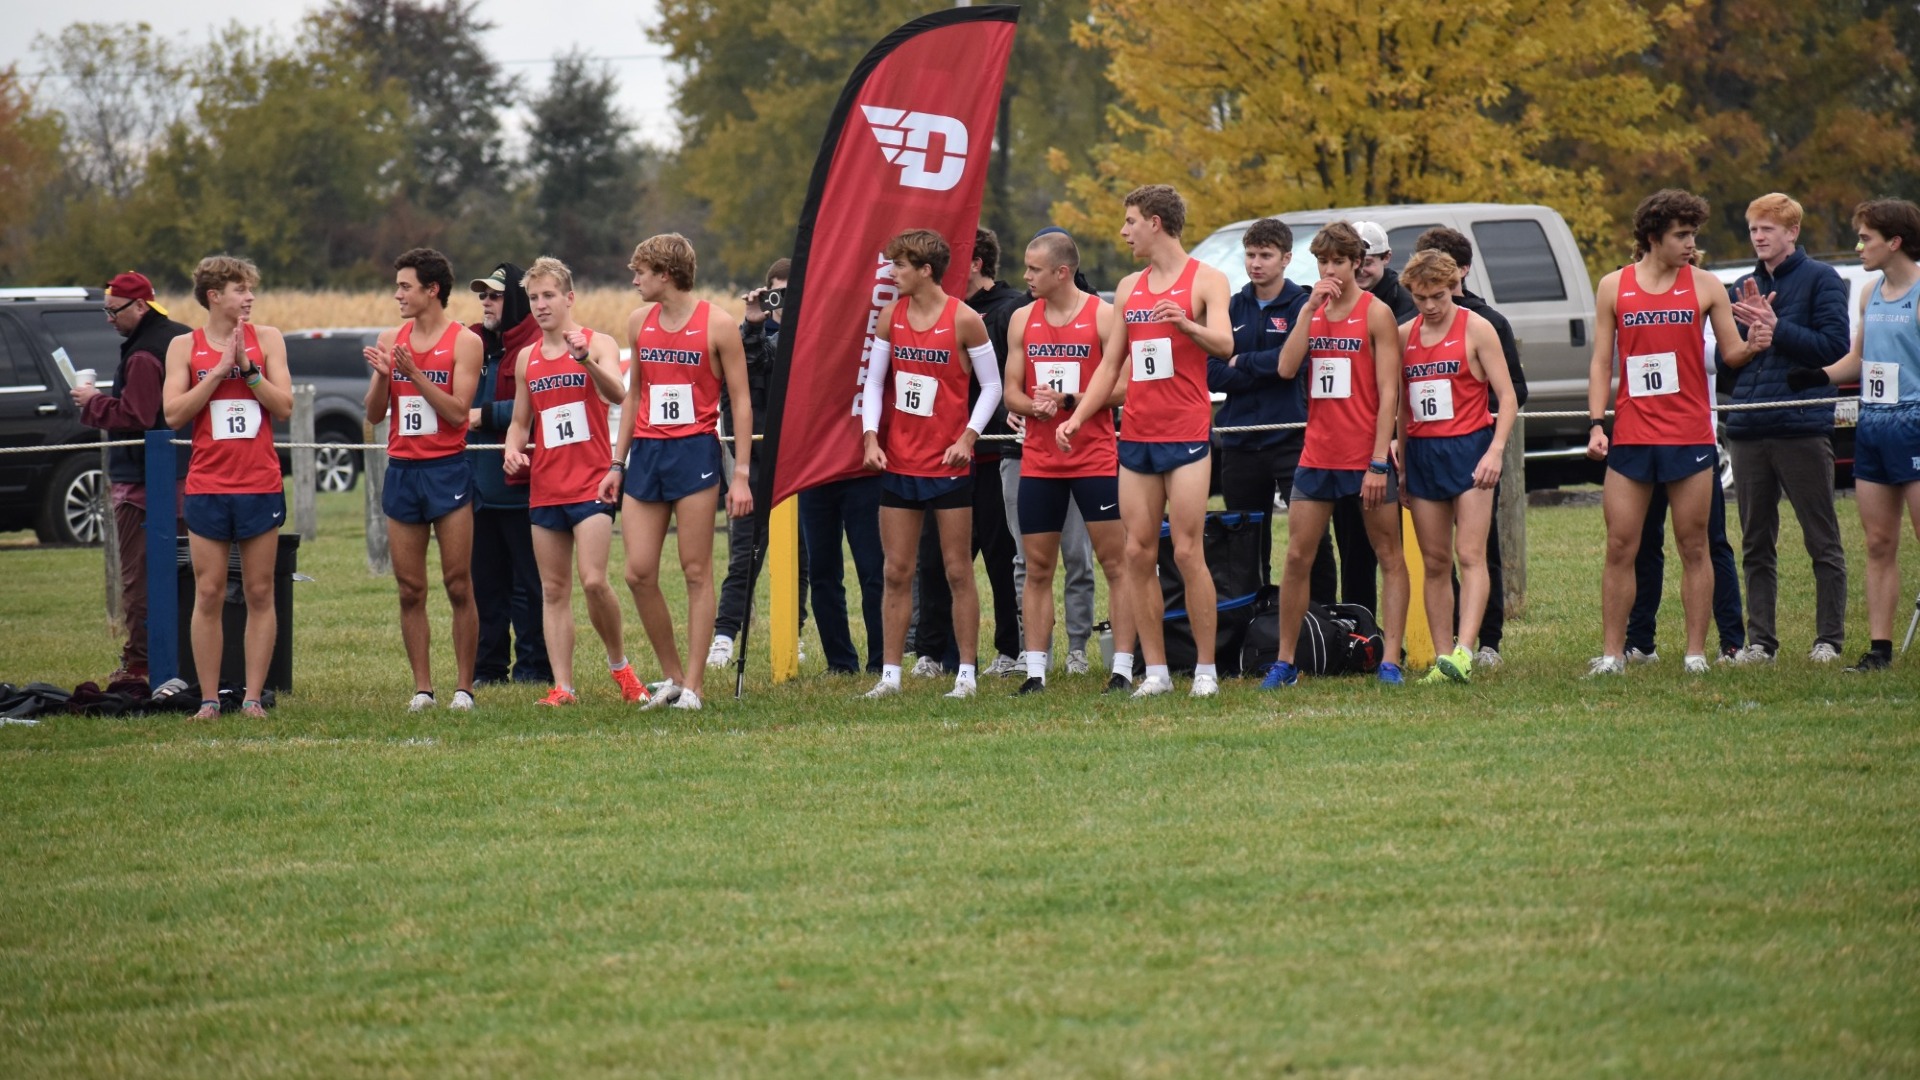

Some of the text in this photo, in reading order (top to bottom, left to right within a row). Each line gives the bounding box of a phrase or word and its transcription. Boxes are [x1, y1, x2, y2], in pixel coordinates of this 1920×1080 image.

[1623, 310, 1694, 327] DAYTON
[639, 348, 702, 366] DAYTON
[1028, 344, 1091, 358] DAYTON
[1144, 356, 1156, 375] 9
[528, 373, 586, 394] DAYTON
[1048, 378, 1063, 393] 11
[1319, 375, 1334, 393] 17
[1642, 371, 1662, 391] 10
[904, 390, 921, 410] 15
[1420, 397, 1437, 416] 16
[661, 401, 680, 420] 18
[226, 416, 246, 433] 13
[404, 412, 422, 431] 19
[555, 420, 575, 441] 14
